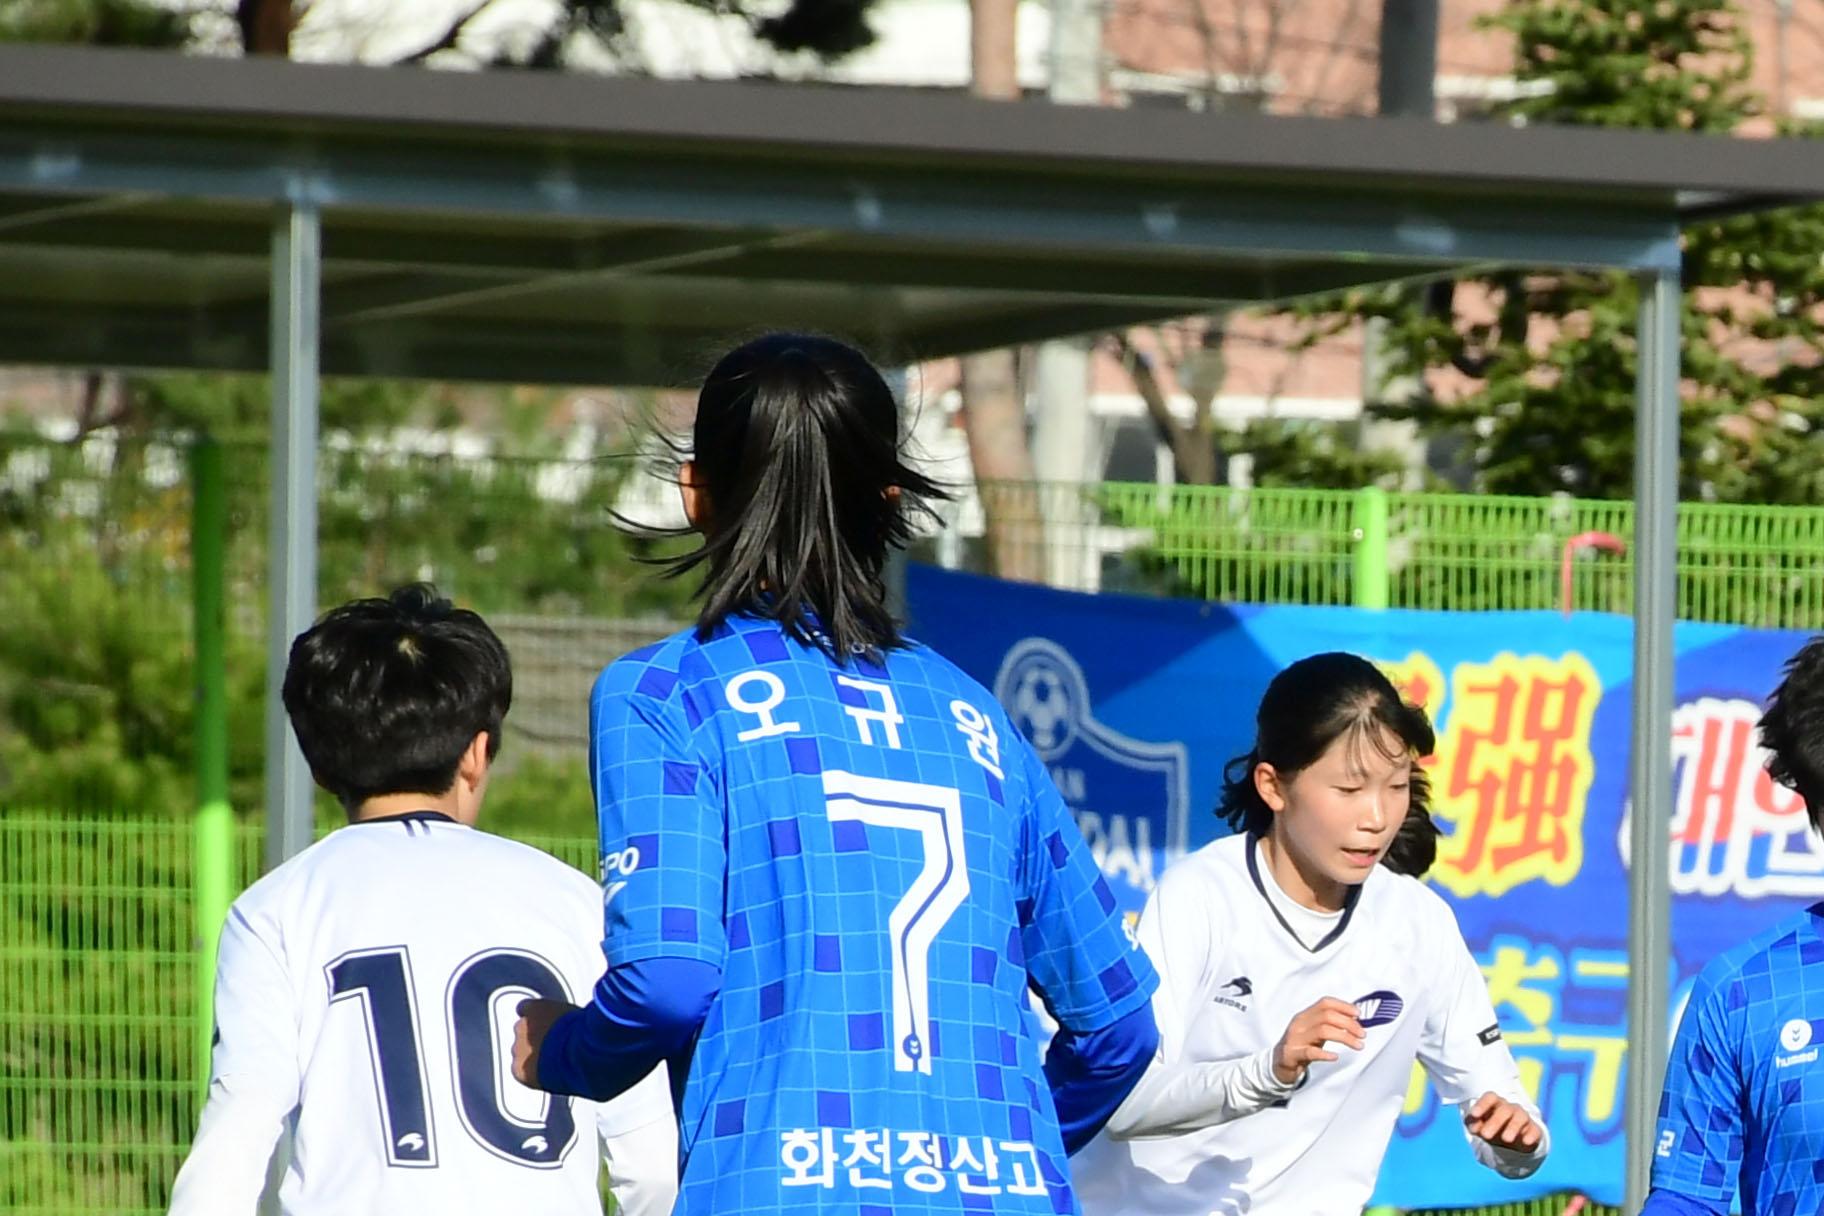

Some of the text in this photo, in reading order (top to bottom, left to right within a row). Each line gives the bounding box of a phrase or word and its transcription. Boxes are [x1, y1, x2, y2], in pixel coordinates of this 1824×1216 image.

[822, 769, 970, 1076] 7
[322, 944, 582, 1170] 10
[1775, 1048, 1819, 1068] hummel
[780, 1128, 1049, 1198] 화천정산고
